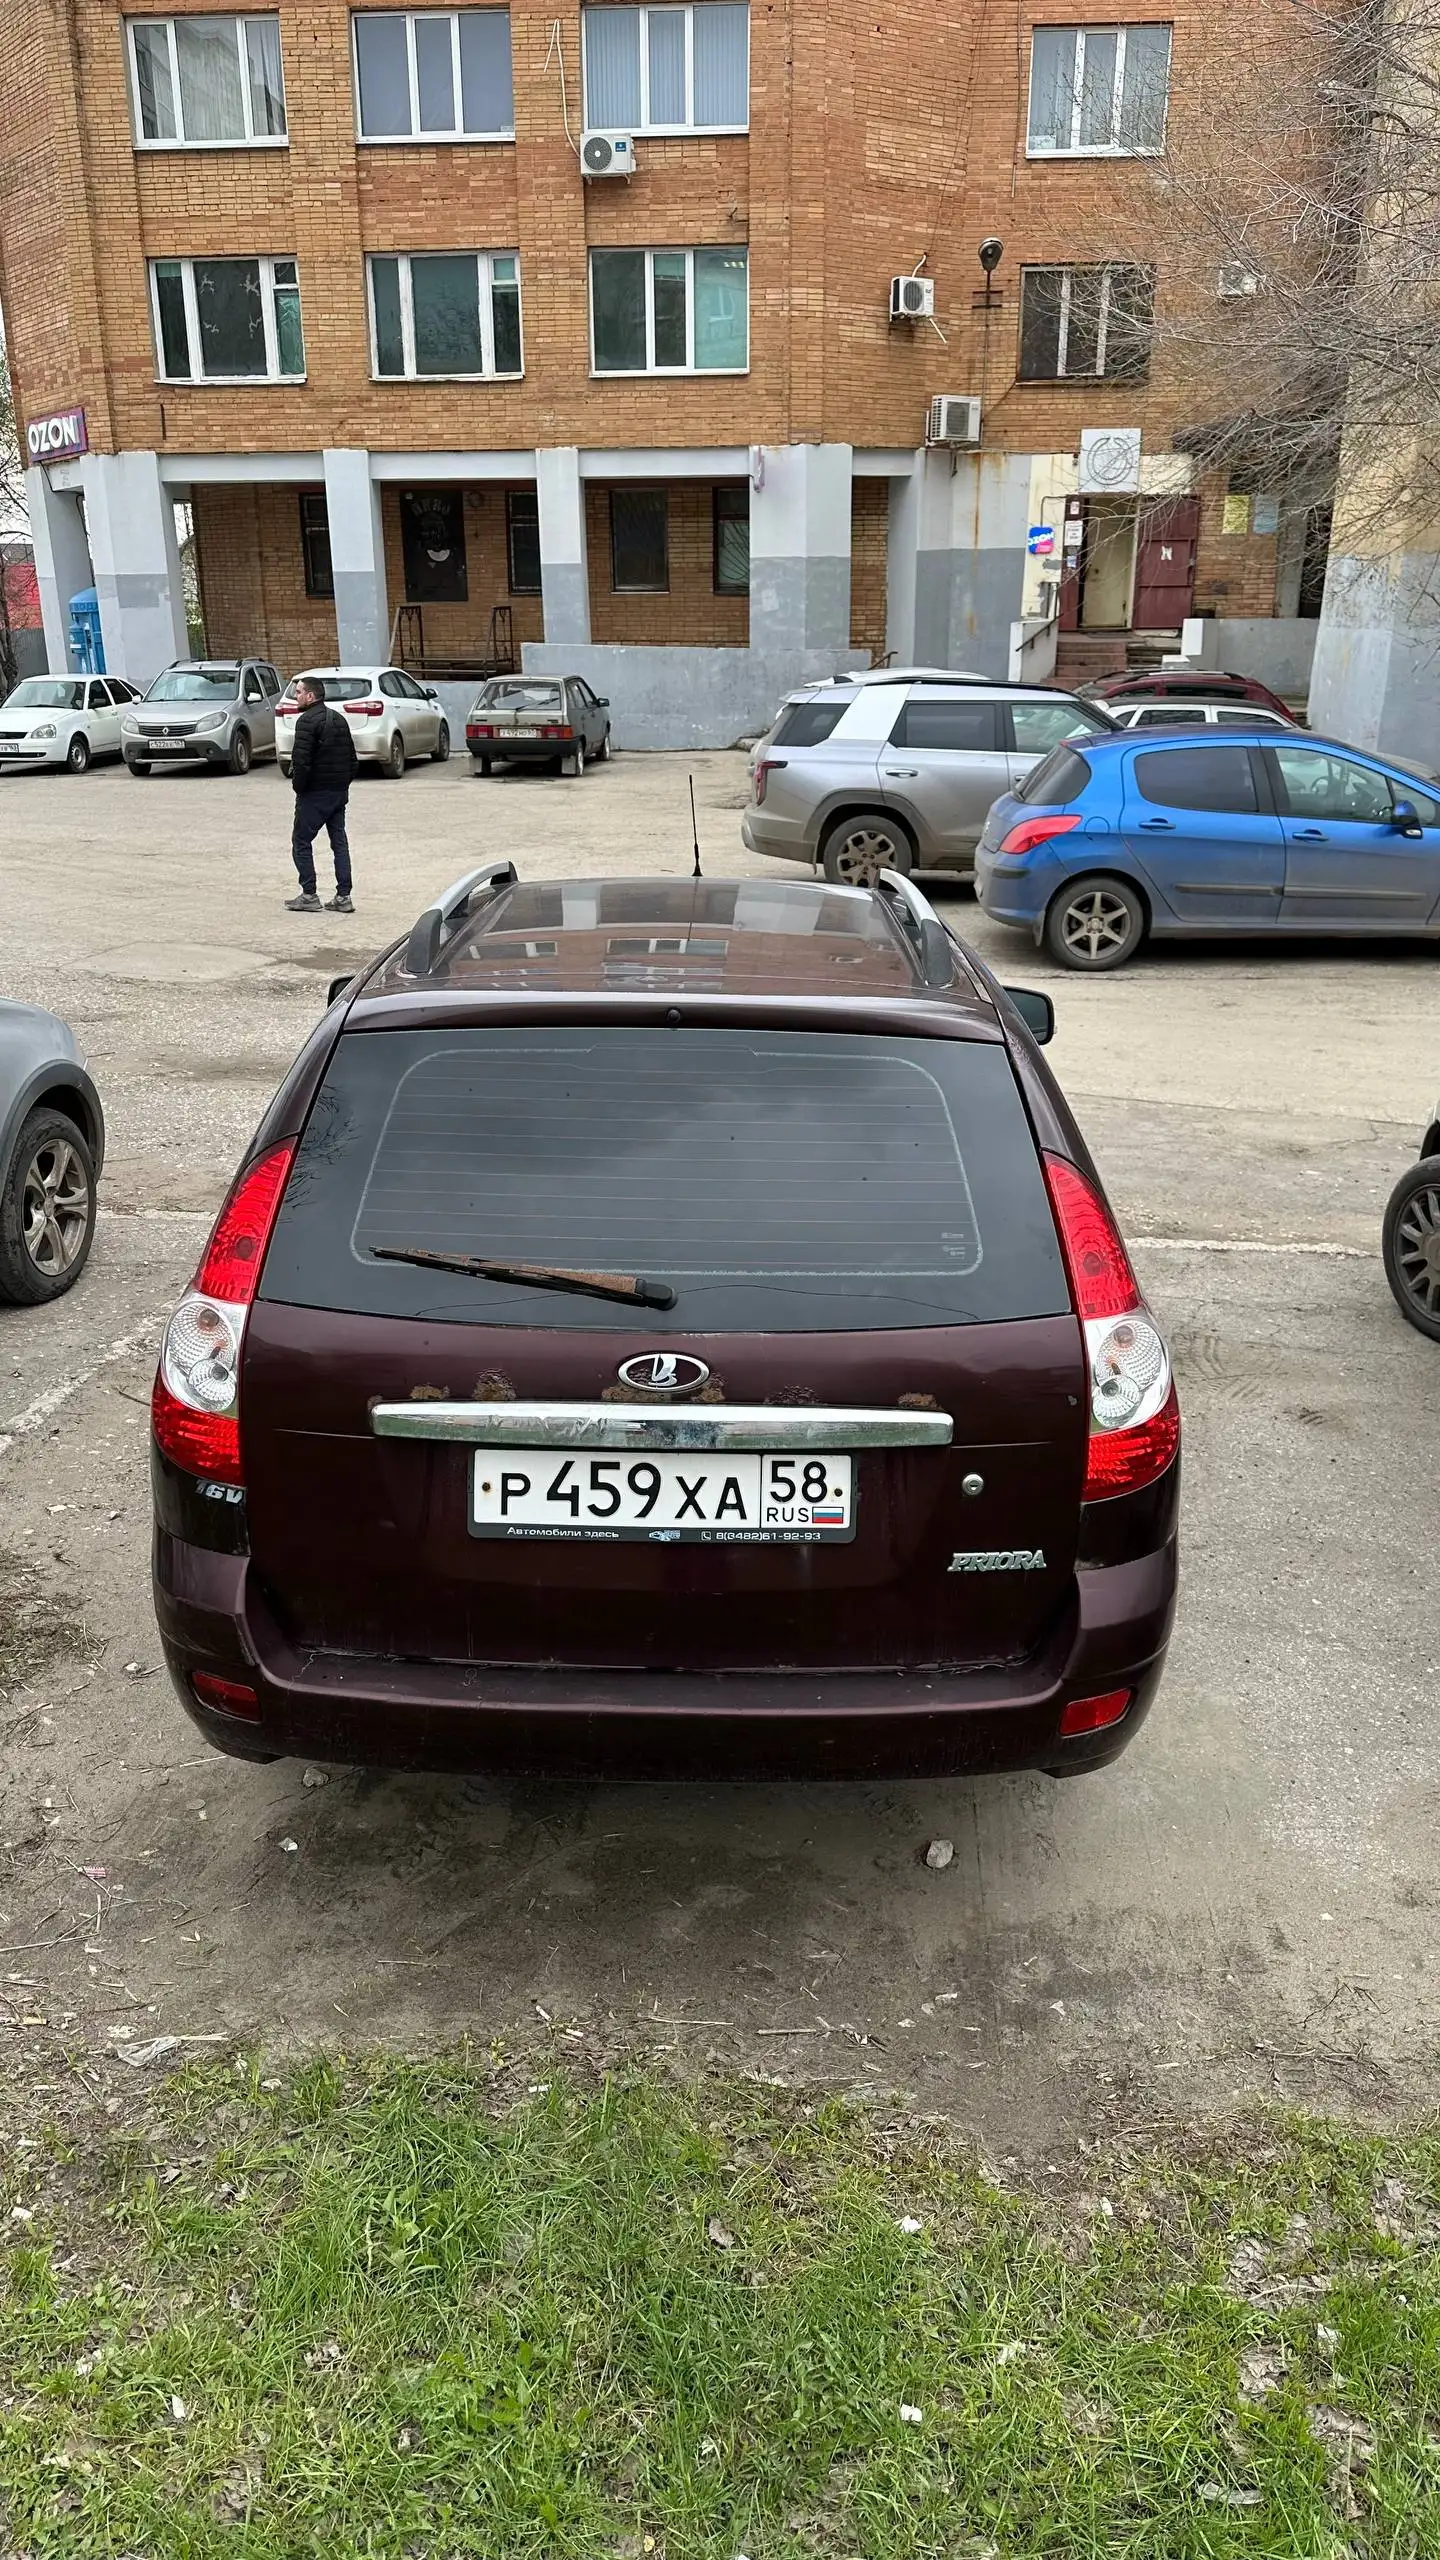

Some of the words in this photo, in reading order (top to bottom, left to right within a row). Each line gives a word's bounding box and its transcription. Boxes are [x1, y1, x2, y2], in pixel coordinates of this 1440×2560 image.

[28, 415, 78, 454] OZON
[769, 1460, 827, 1503] 58
[766, 1507, 809, 1523] RUS
[507, 1526, 581, 1537] Автомобили
[947, 1549, 1047, 1572] PRIORA
